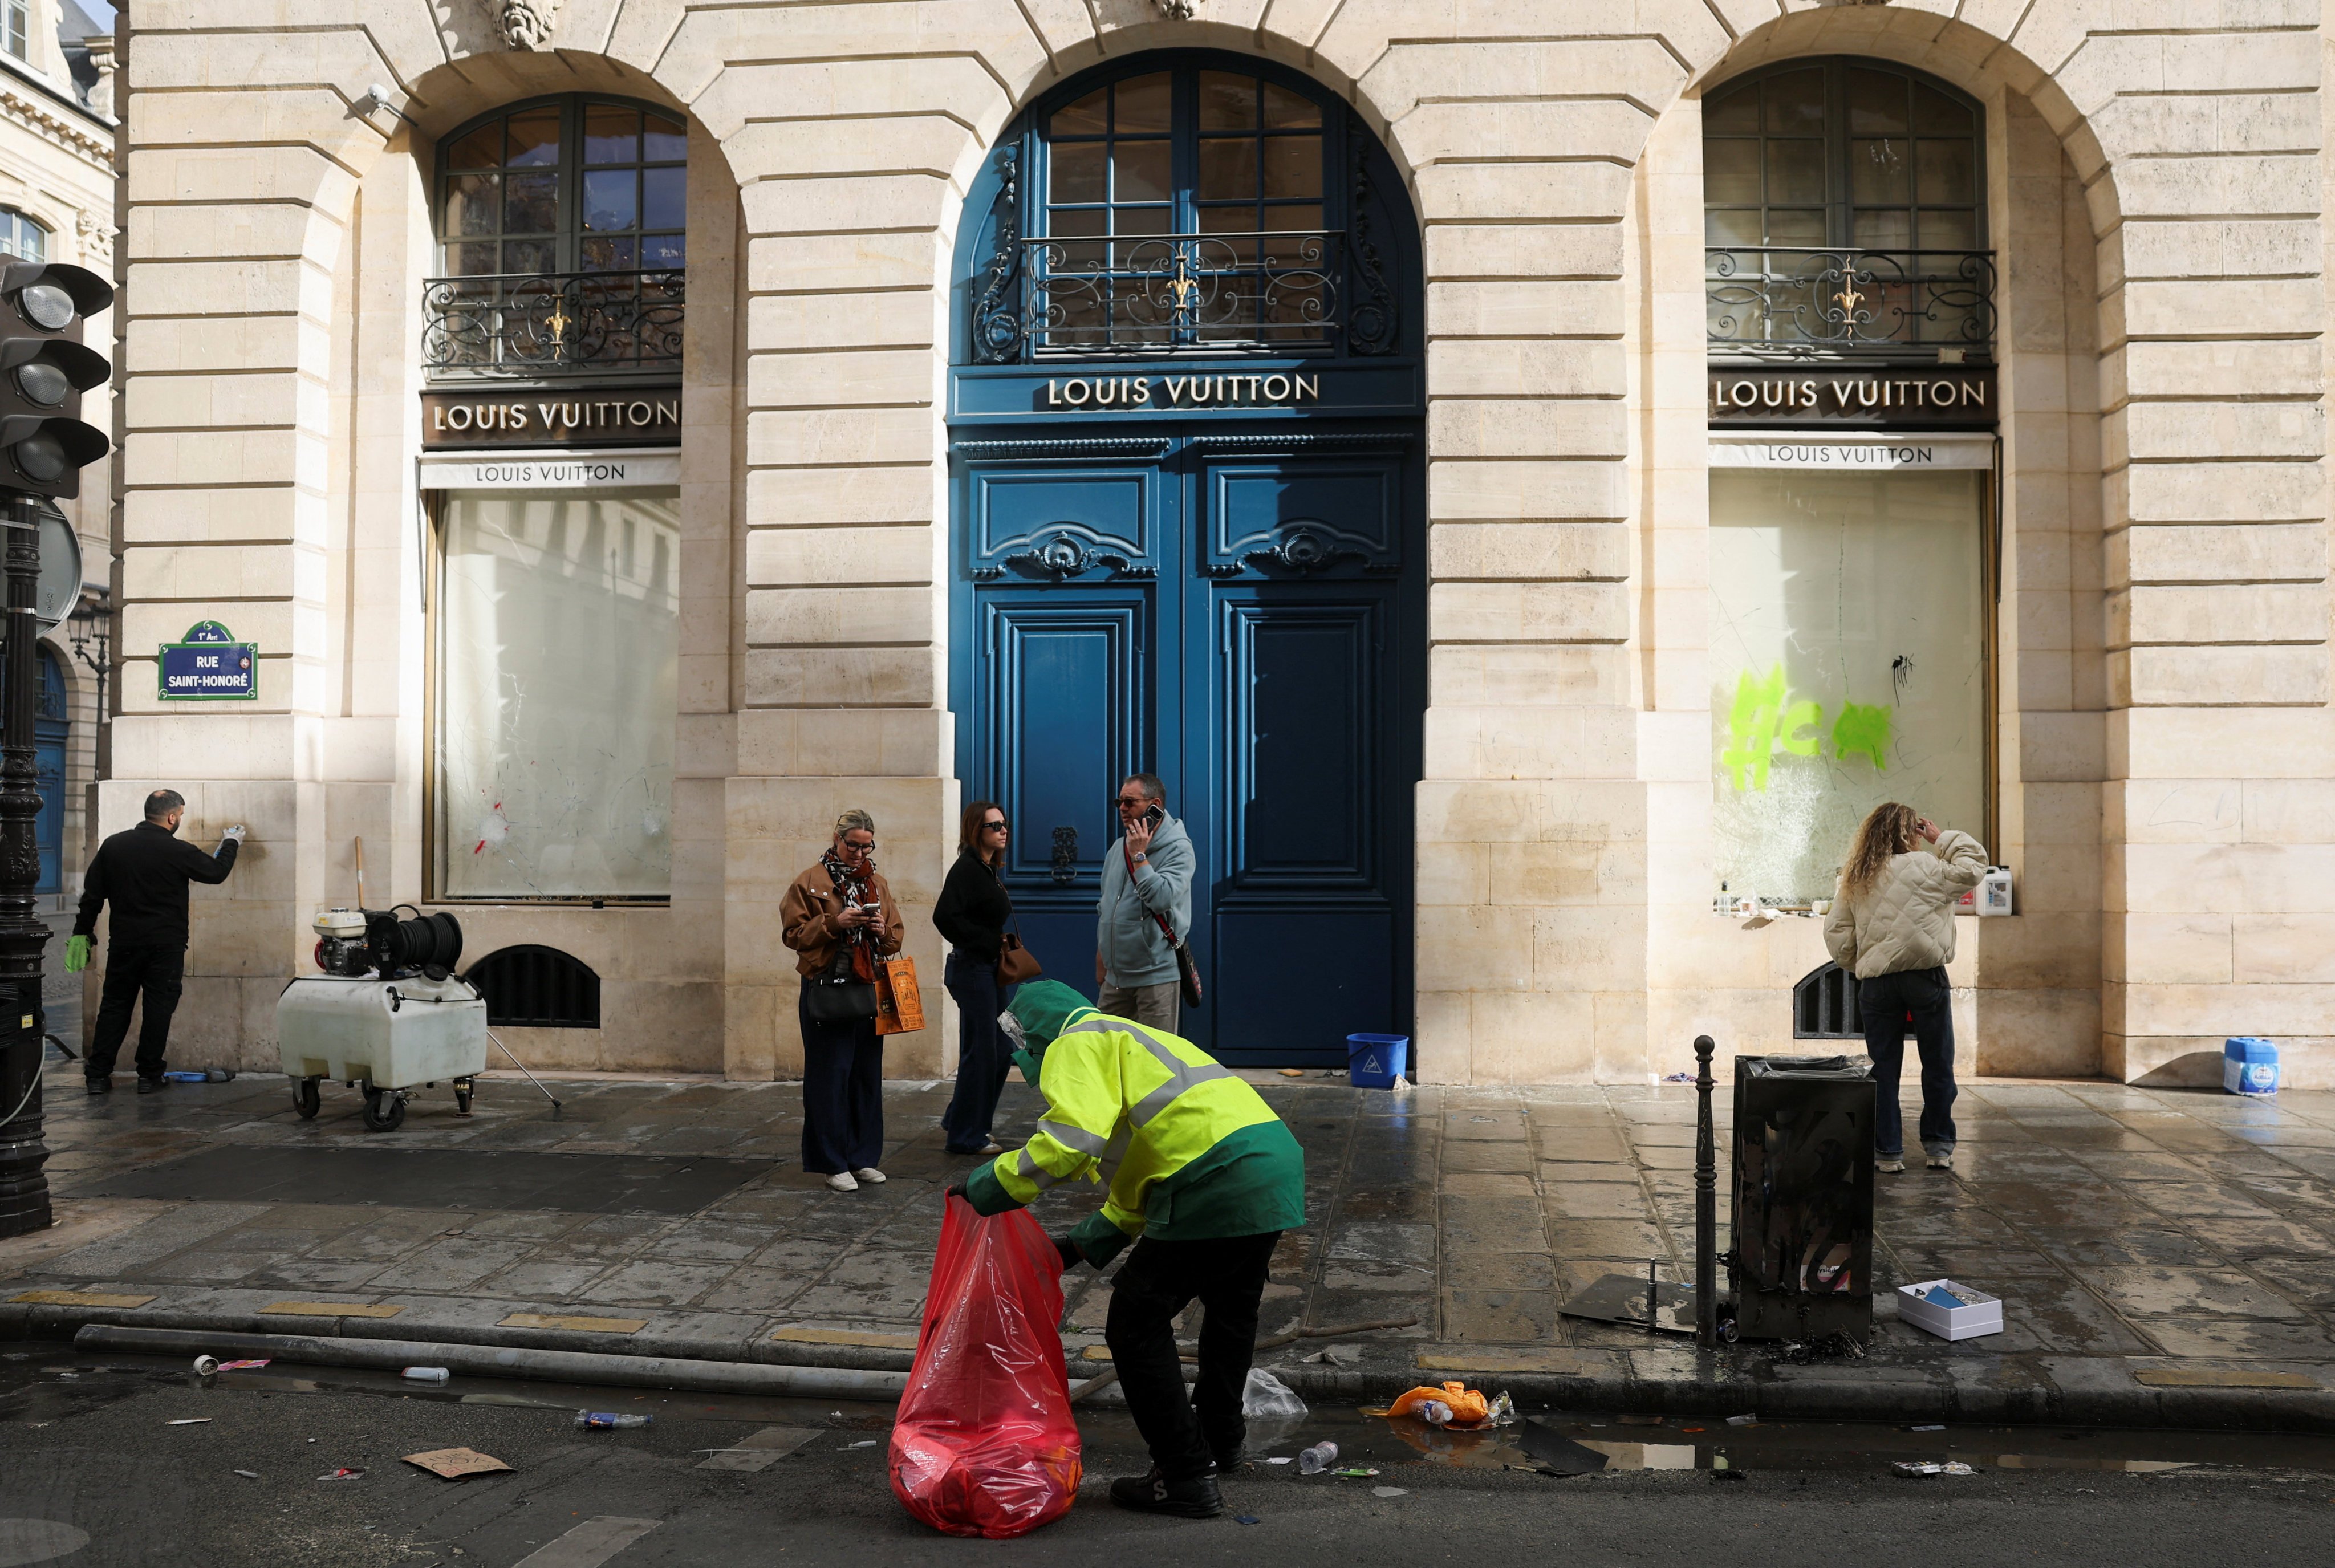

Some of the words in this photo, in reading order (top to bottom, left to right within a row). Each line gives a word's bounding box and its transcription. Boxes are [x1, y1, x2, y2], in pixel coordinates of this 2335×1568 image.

[1049, 377, 1150, 405] LOUIS
[1165, 373, 1319, 404] VUITTON
[1715, 380, 1818, 408] LOUIS
[1832, 380, 1985, 408] VUITTON
[434, 404, 527, 430] LOUIS
[538, 400, 679, 430] VUITTON
[1769, 445, 1830, 462] LOUIS
[1839, 446, 1932, 463] VUITTON
[477, 466, 532, 482] LOUIS
[541, 464, 625, 481] VUITTON
[196, 656, 219, 668] RUE
[168, 673, 248, 688] SAINT-HONORÉ
